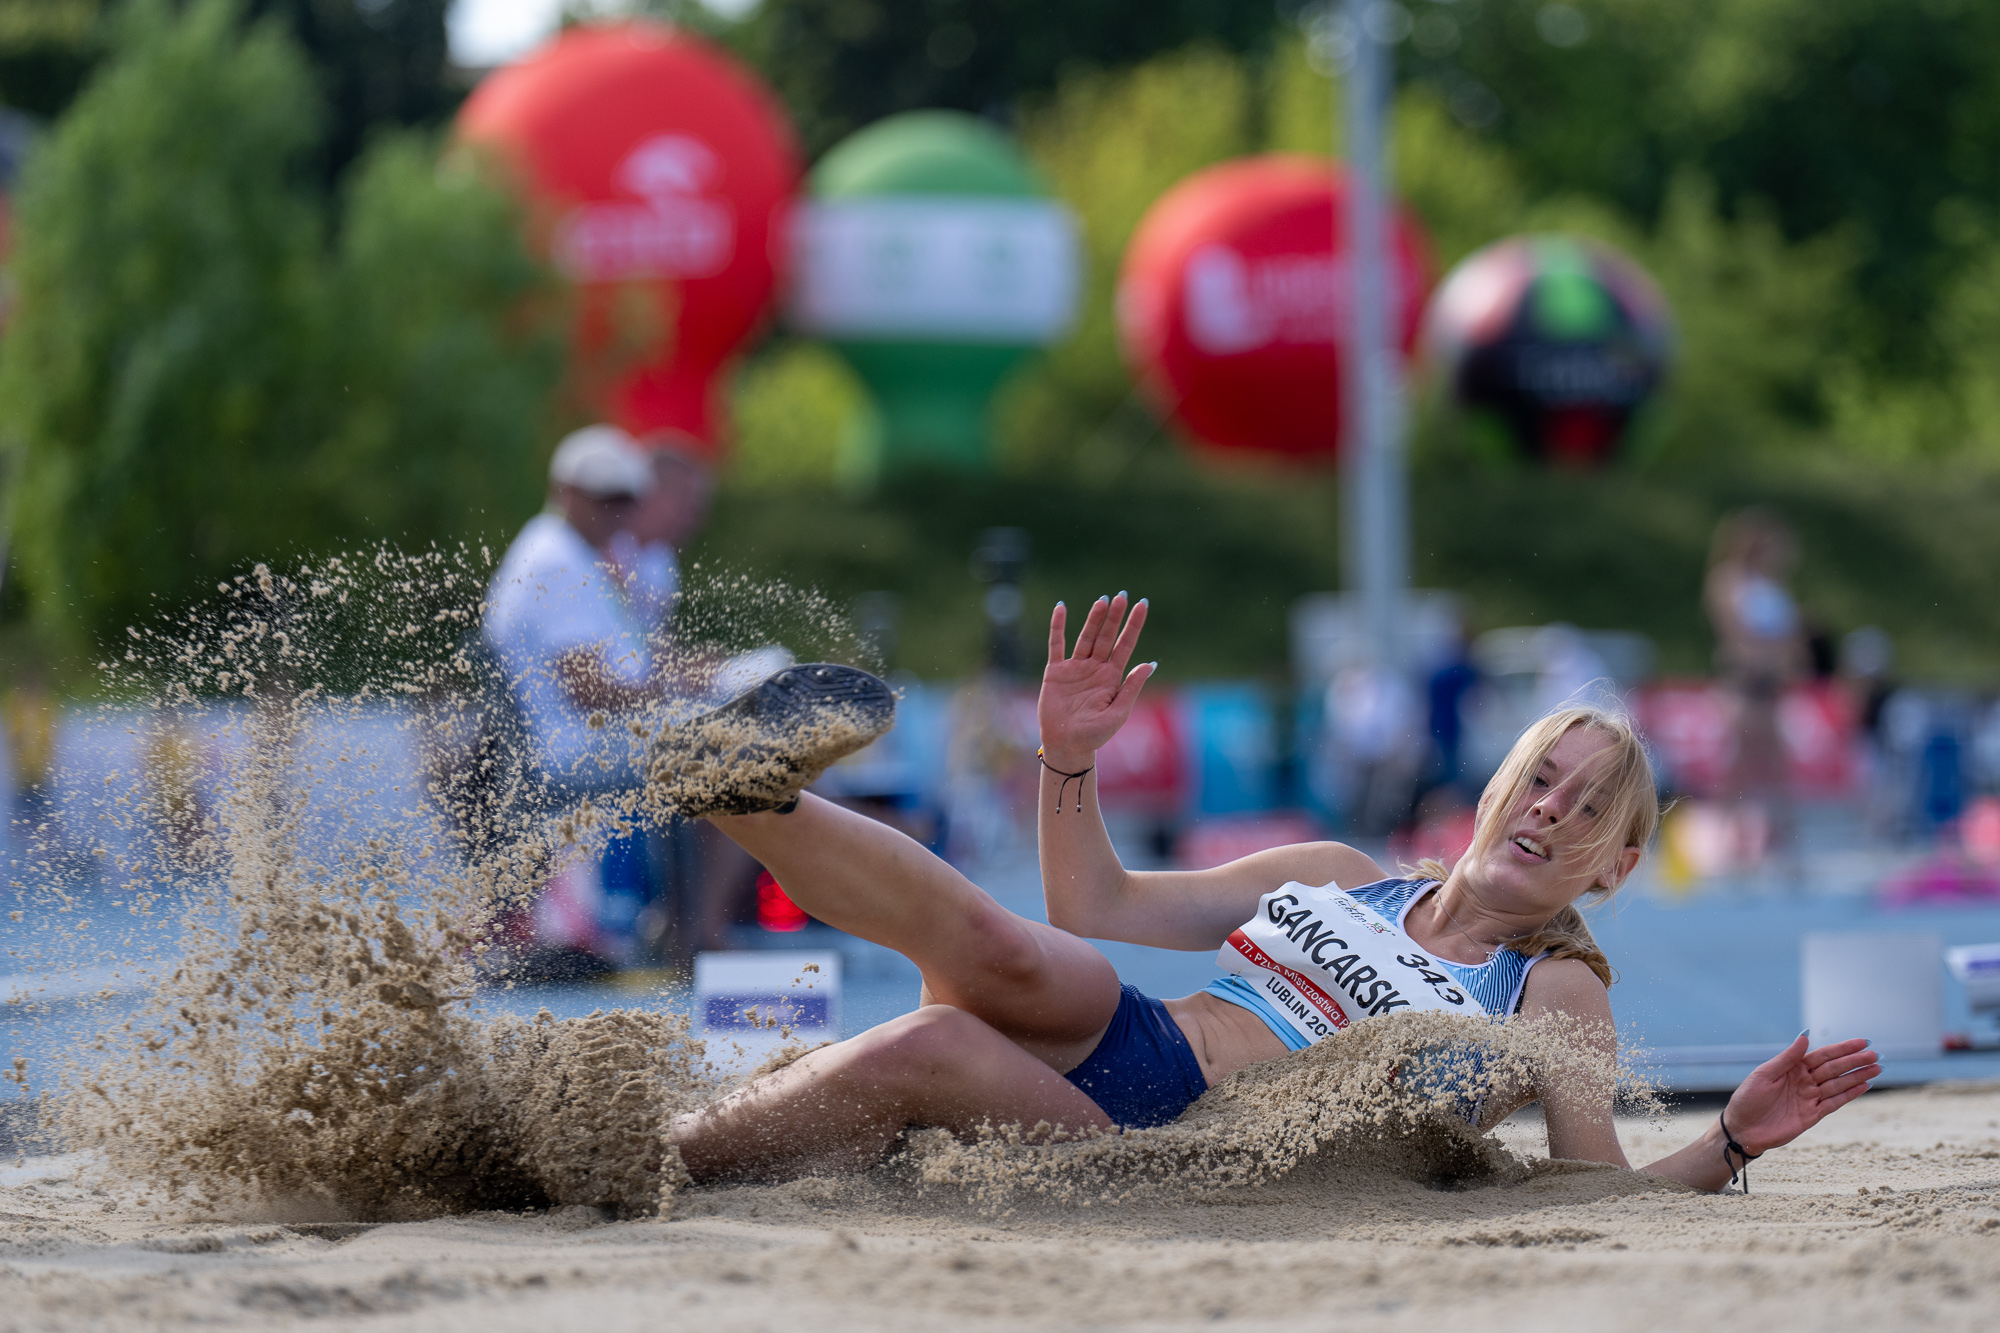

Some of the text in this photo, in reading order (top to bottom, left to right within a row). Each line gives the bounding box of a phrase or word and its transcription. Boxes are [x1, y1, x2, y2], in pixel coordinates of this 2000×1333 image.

[1239, 939, 1254, 958] 77.
[1254, 952, 1281, 973] PZLA
[1284, 968, 1341, 1021] Mistrzostwa
[1265, 976, 1311, 1020] LUBLIN
[1396, 953, 1465, 1006] 343
